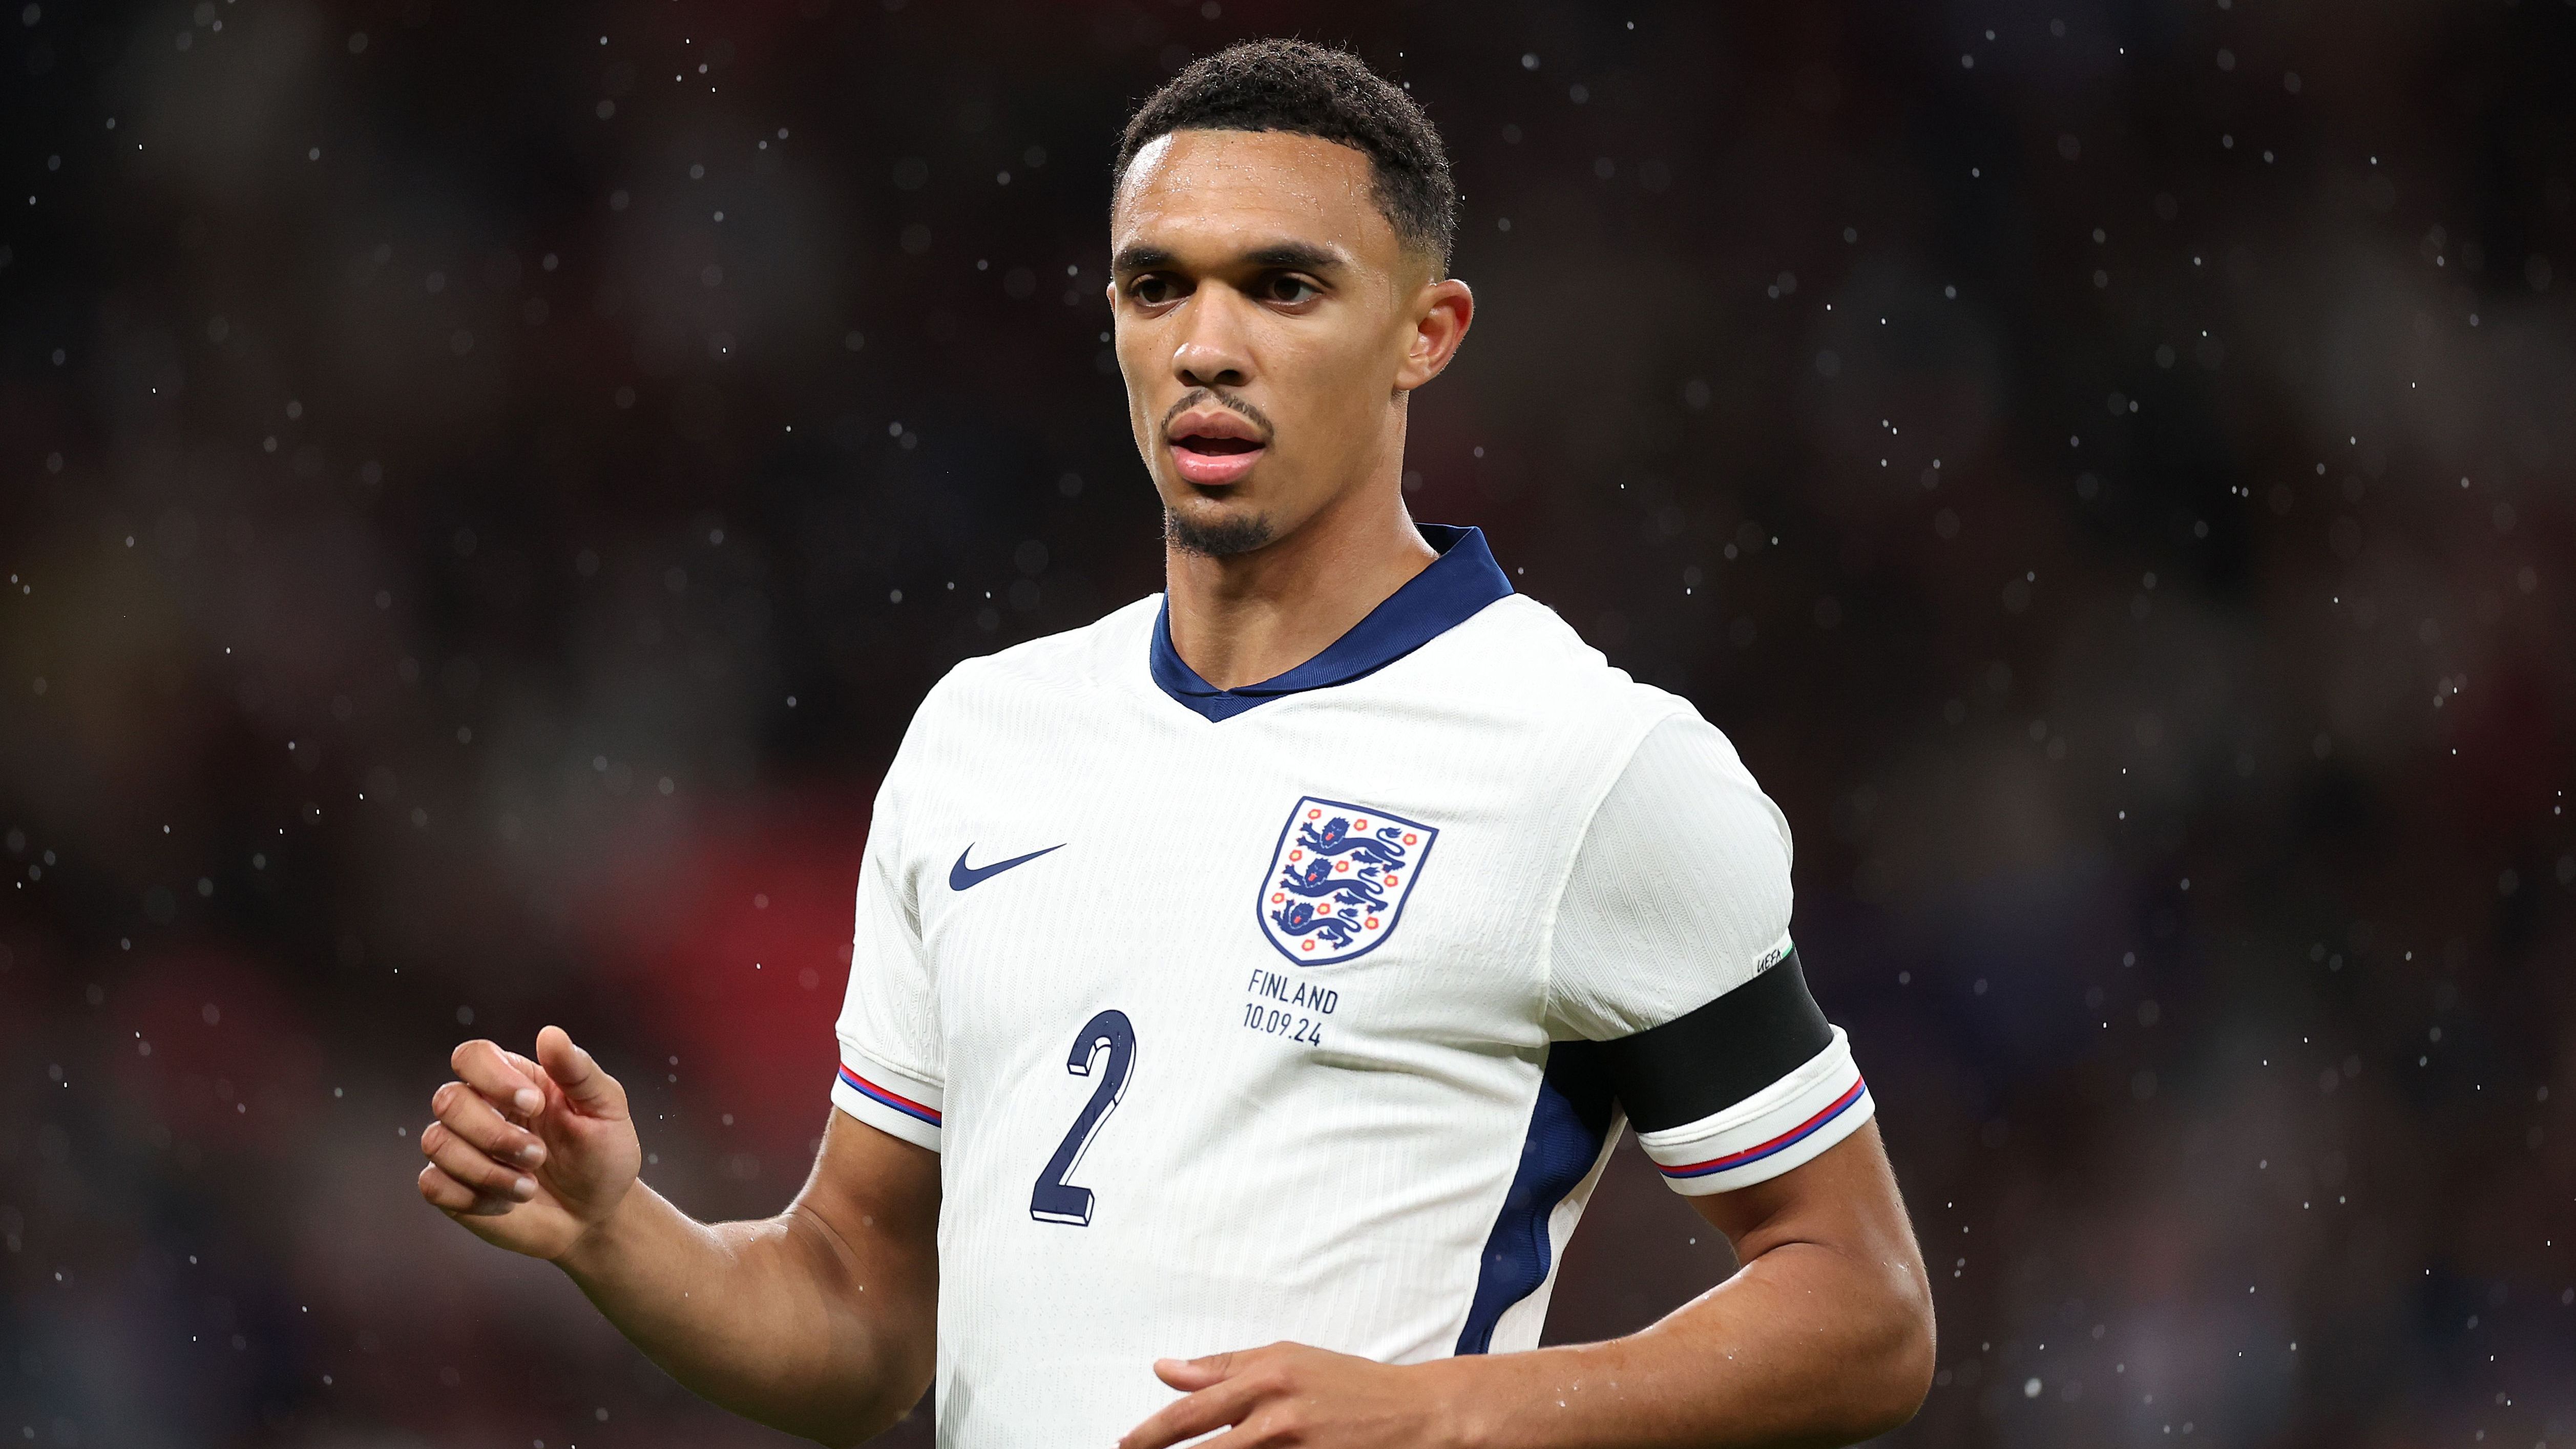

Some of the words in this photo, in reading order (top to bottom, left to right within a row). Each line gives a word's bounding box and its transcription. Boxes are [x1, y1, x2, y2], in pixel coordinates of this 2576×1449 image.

[1757, 948, 1782, 973] UEFA
[1248, 969, 1338, 1015] FINLAND
[1244, 1003, 1321, 1047] 10.09.24
[1030, 1010, 1136, 1227] 2
